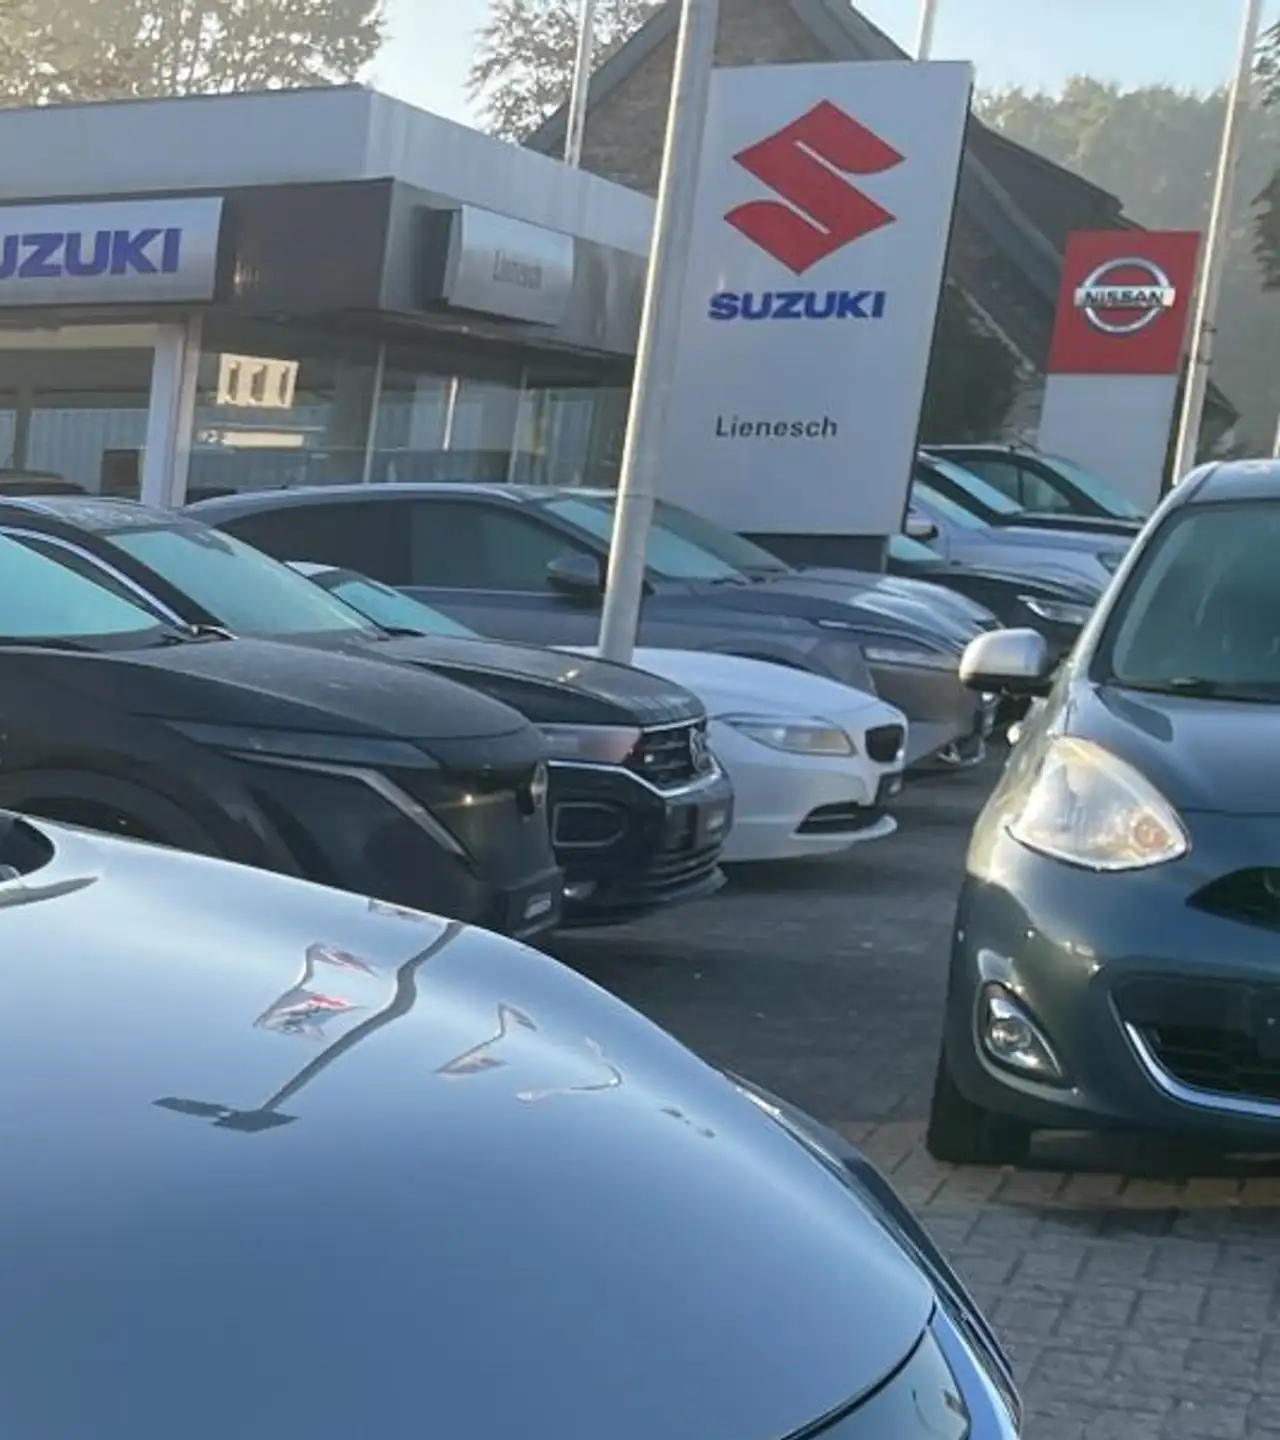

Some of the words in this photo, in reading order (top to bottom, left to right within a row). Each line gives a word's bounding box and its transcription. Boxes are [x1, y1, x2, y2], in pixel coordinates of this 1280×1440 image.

[707, 290, 887, 320] SUZUKI
[1084, 290, 1165, 304] NISSAN
[715, 415, 838, 438] Lienesch
